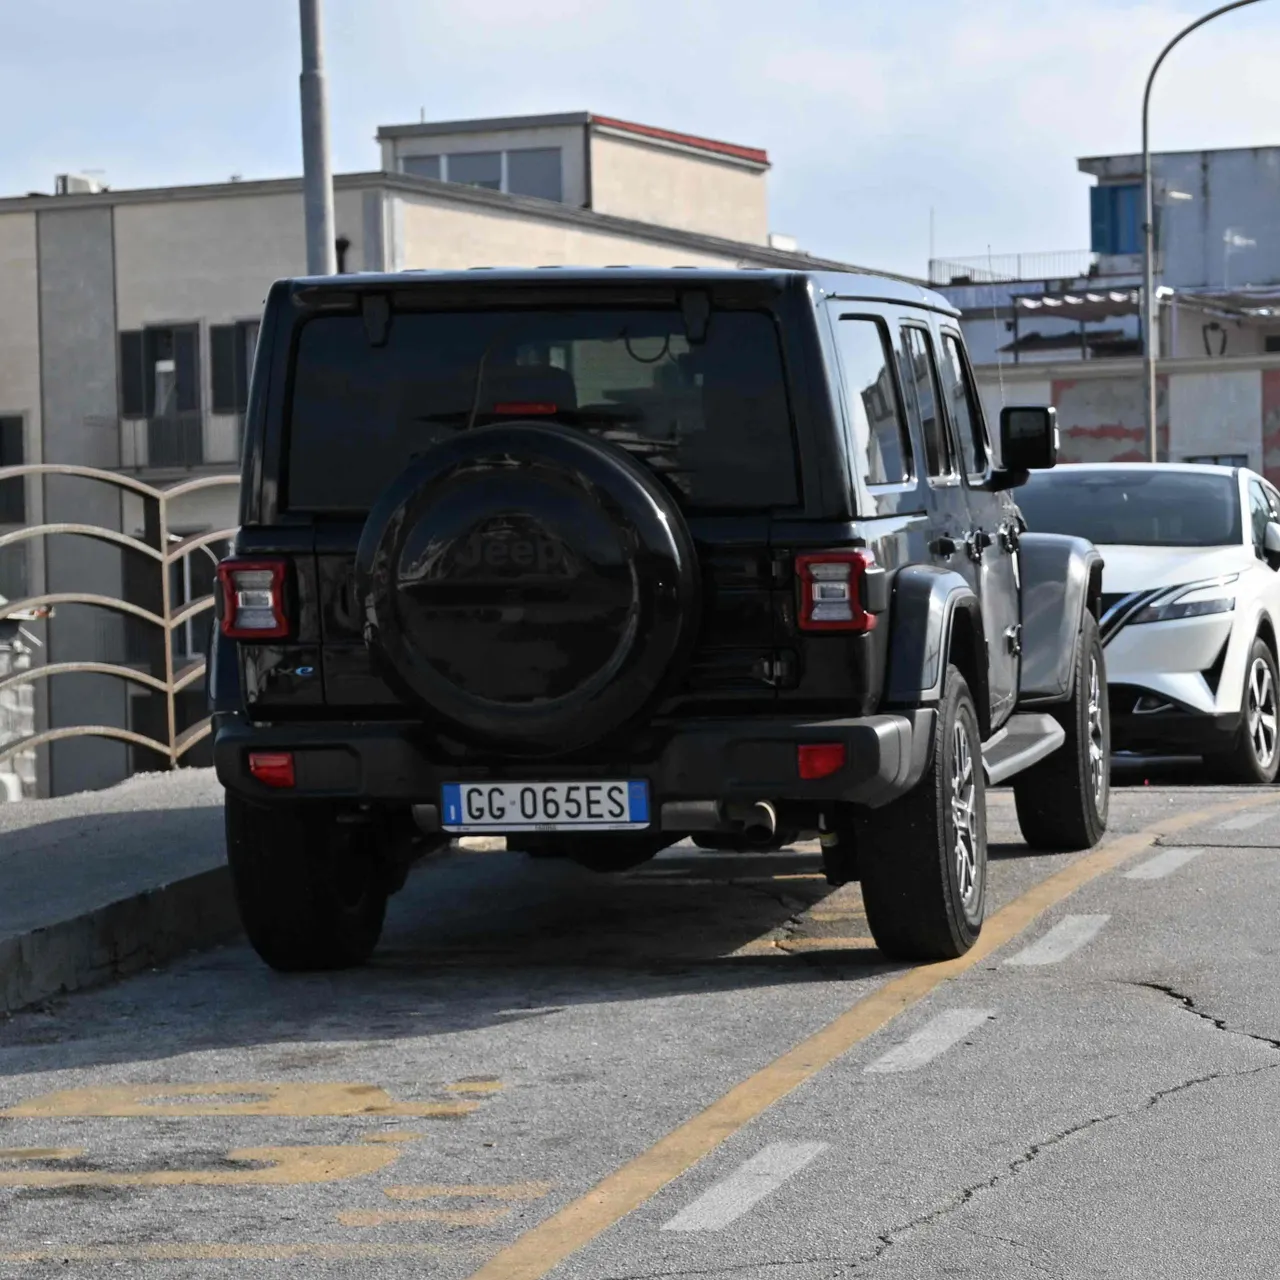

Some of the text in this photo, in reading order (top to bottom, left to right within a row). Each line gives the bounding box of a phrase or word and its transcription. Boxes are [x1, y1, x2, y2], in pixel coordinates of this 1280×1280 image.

[454, 533, 563, 573] Jeep
[466, 787, 505, 820] GG
[520, 785, 625, 820] 065ES
